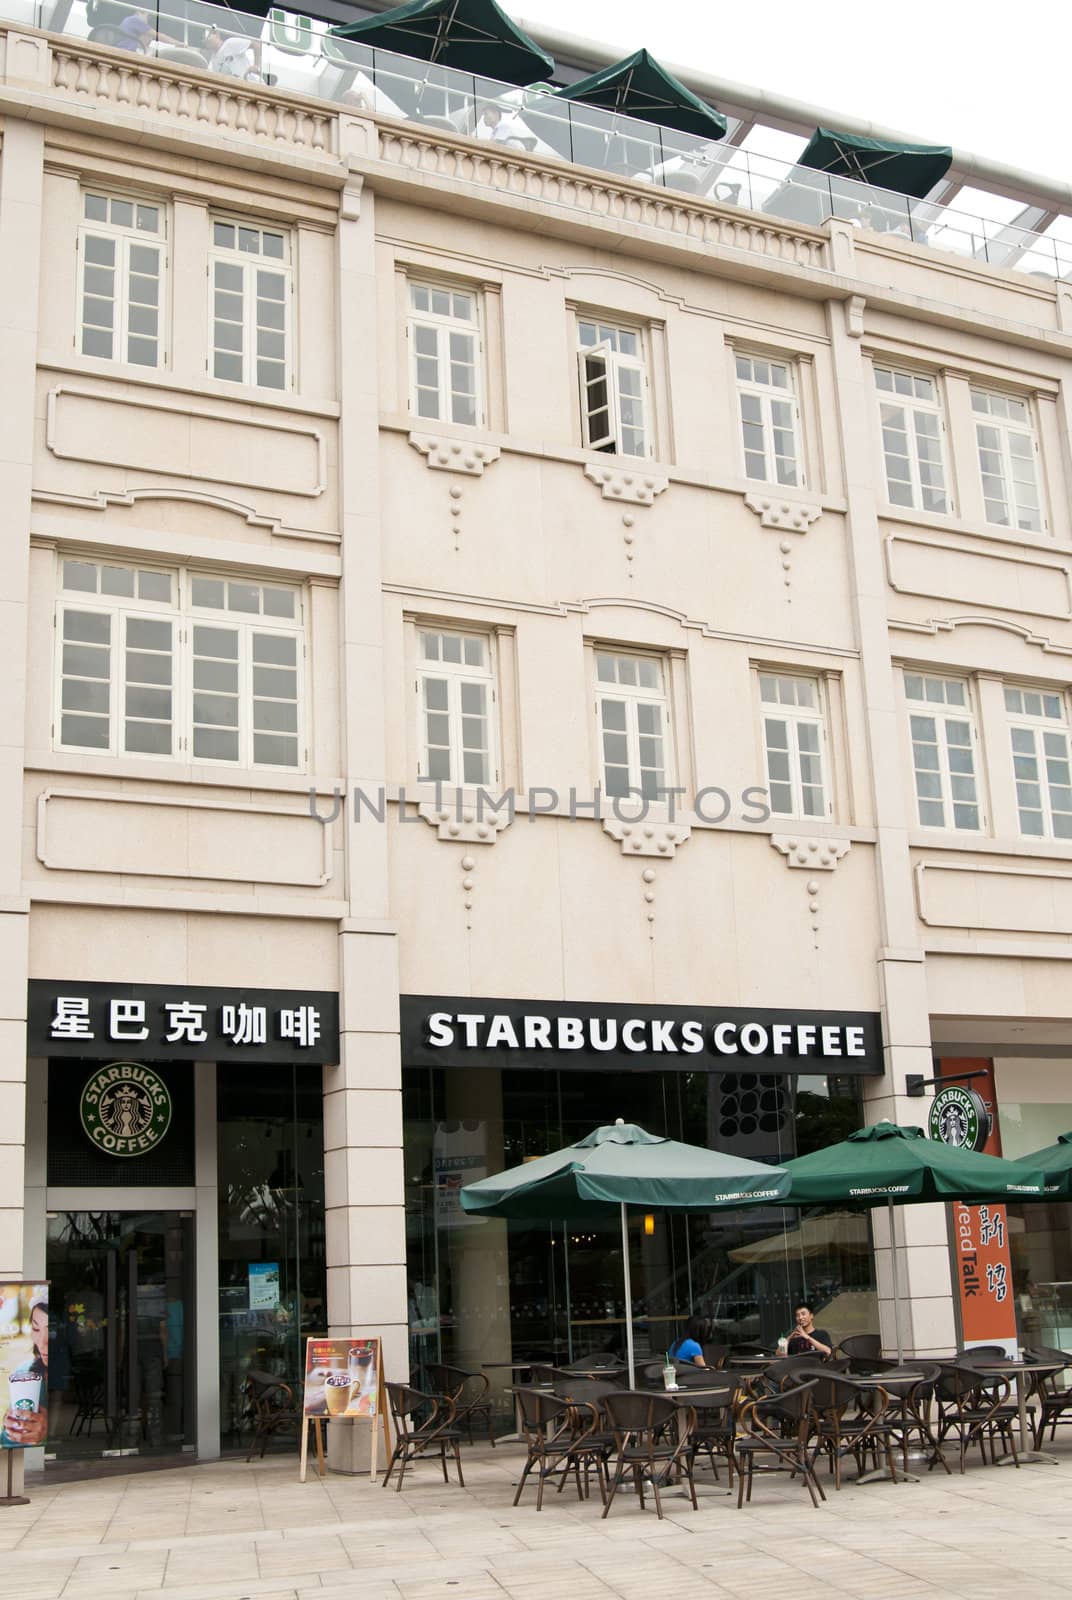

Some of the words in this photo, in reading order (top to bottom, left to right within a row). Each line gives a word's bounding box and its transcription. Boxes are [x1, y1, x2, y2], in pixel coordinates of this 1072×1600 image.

[51, 996, 321, 1046] 星巴克咖啡
[427, 1012, 703, 1053] STARBUCKS
[714, 1023, 866, 1056] COFFEE
[85, 1066, 167, 1106] STARBUCKS
[931, 1090, 975, 1126] STARBUCKS
[92, 1126, 158, 1152] COFFEE
[958, 1201, 981, 1297] readTalk
